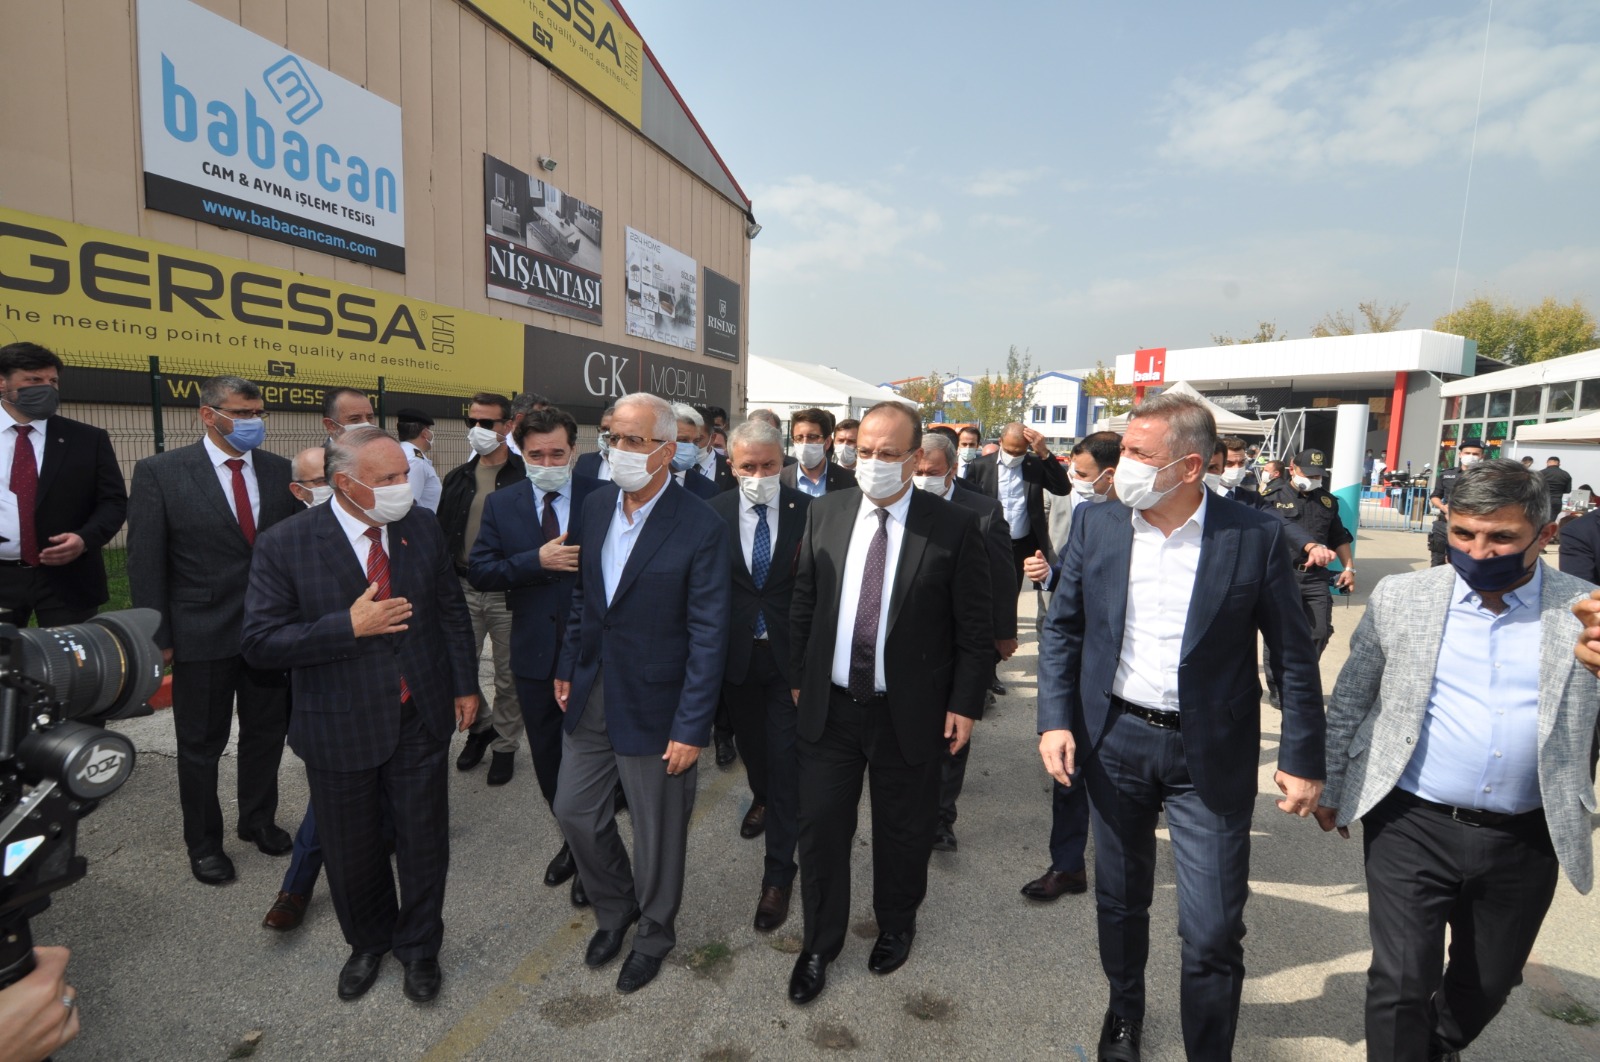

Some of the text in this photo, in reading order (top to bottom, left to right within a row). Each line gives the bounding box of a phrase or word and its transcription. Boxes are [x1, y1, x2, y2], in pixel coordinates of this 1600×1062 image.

[547, 17, 577, 47] quality
[578, 44, 595, 61] and
[161, 51, 397, 214] babacan
[202, 161, 235, 182] CAM
[239, 173, 250, 187] &
[253, 177, 292, 200] AYNA
[203, 199, 377, 258] www.babacancam.com
[489, 242, 602, 309] NİŞANTAŞI
[53, 313, 157, 340] meeting
[167, 328, 221, 346] point
[228, 335, 248, 347] of
[253, 336, 282, 351] the
[289, 343, 344, 361] quality
[349, 352, 376, 363] and
[431, 314, 455, 355] SOFA
[707, 315, 737, 336] RISING
[583, 351, 707, 399] GK MOBILIA
[1134, 356, 1161, 382] bala
